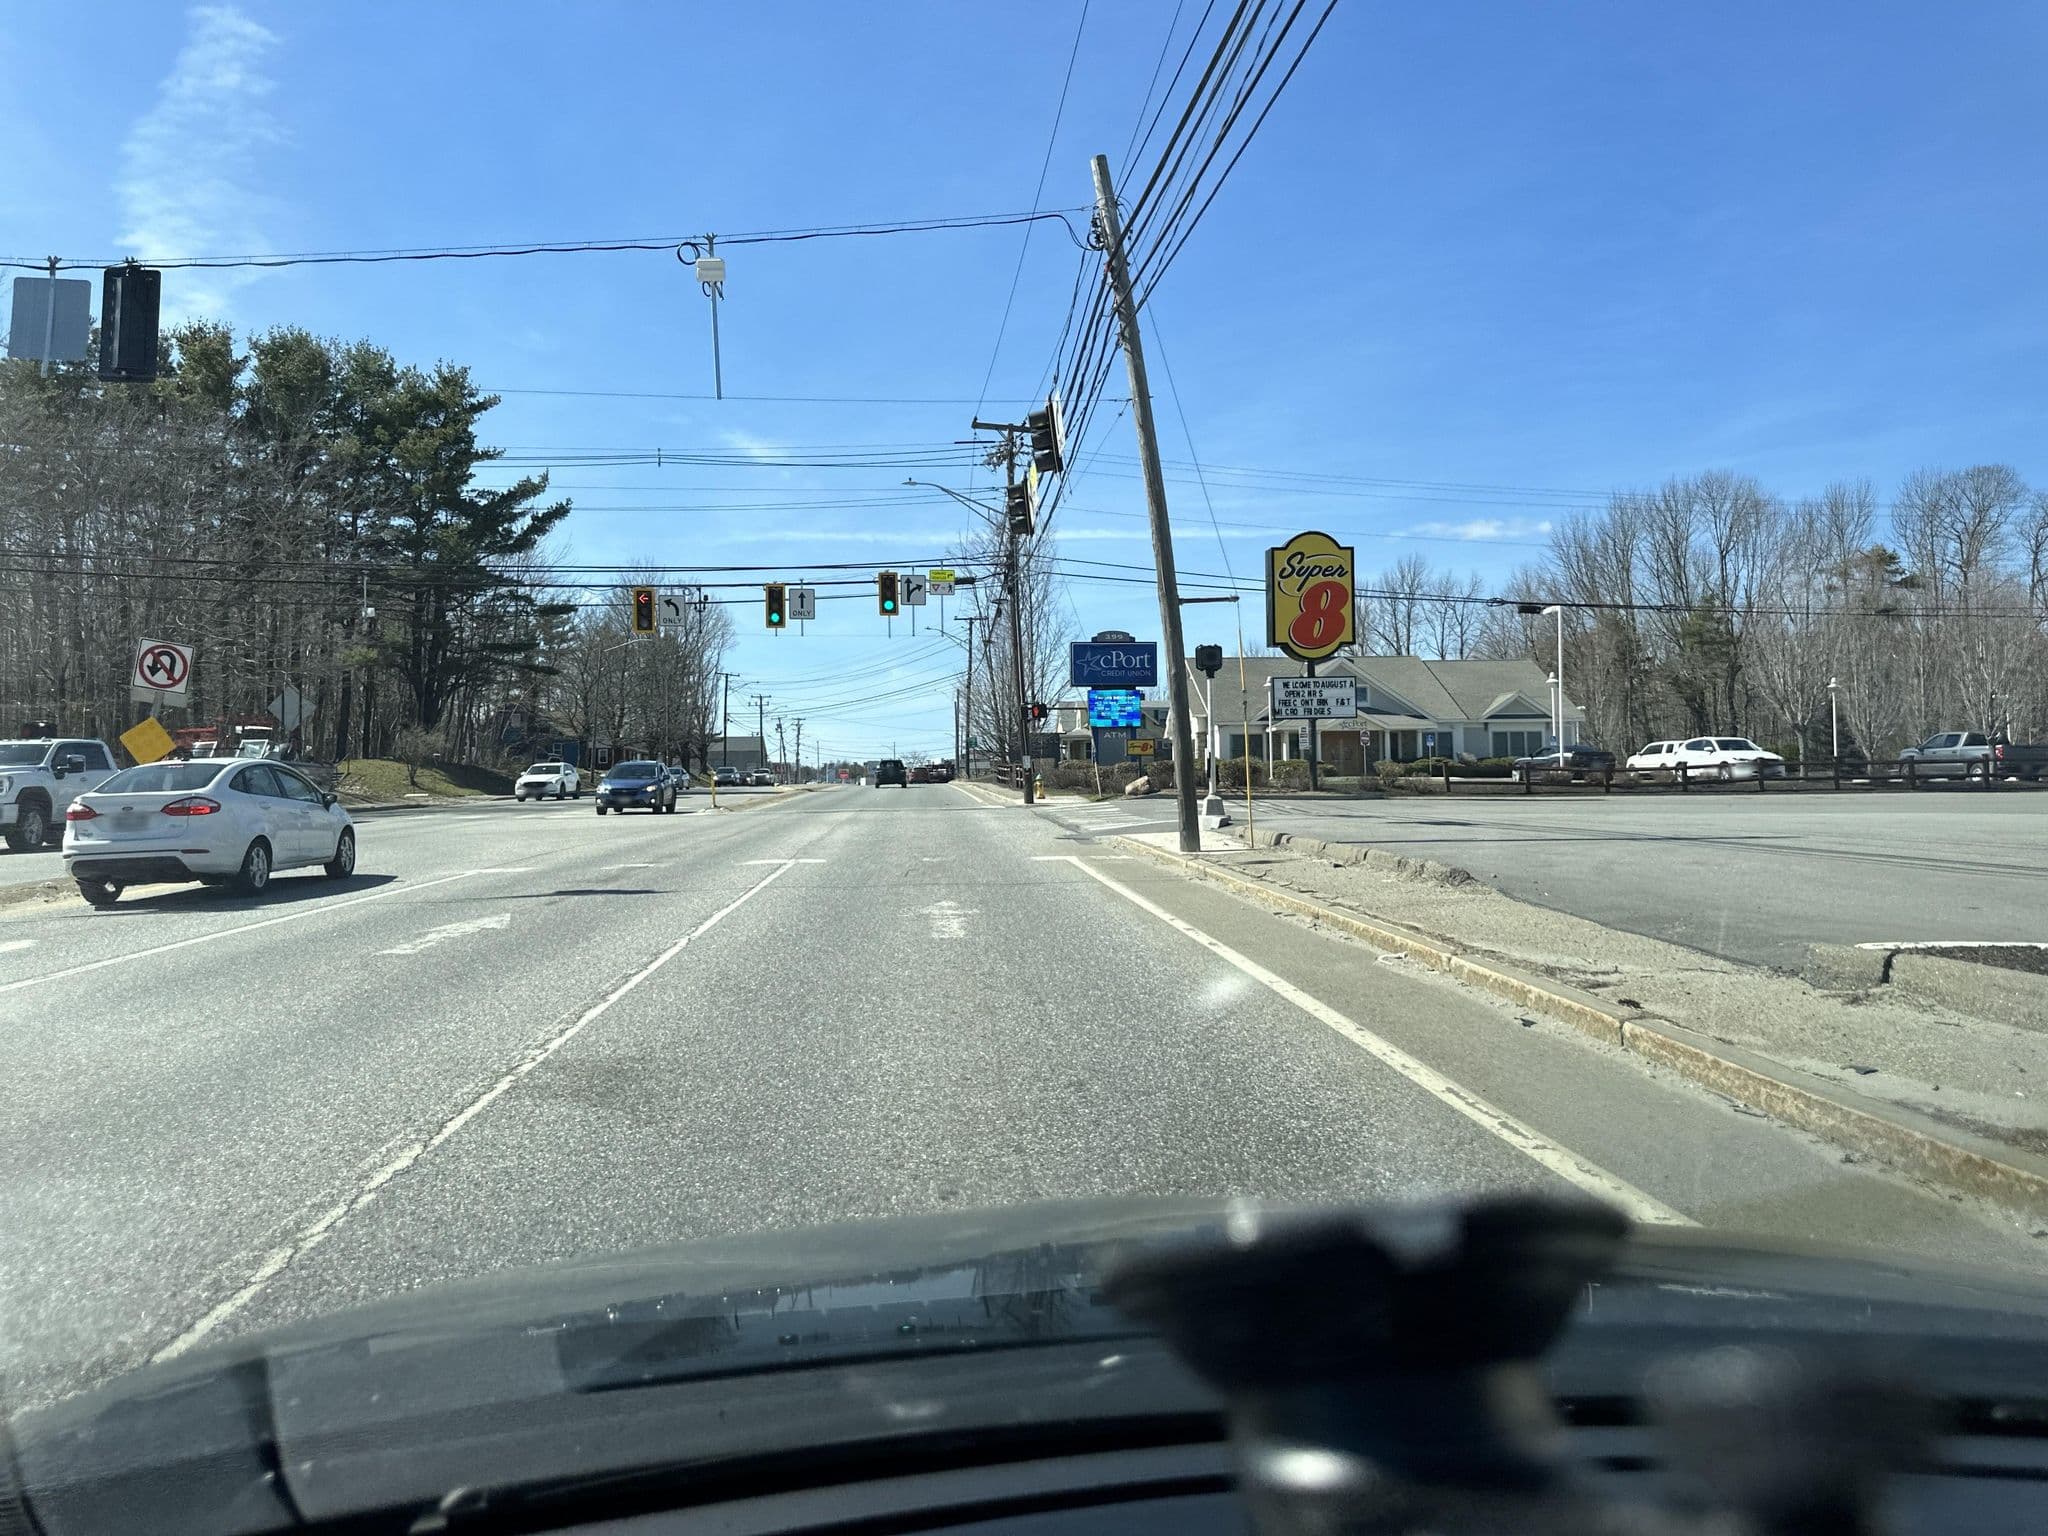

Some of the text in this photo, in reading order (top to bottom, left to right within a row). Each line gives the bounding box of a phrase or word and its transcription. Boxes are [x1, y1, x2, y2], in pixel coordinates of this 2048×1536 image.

[1278, 551, 1349, 594] Super
[792, 609, 813, 617] ONLY
[1288, 580, 1350, 650] 8
[1100, 650, 1152, 669] cPort
[1103, 731, 1127, 739] ATM
[1140, 742, 1149, 752] 8
